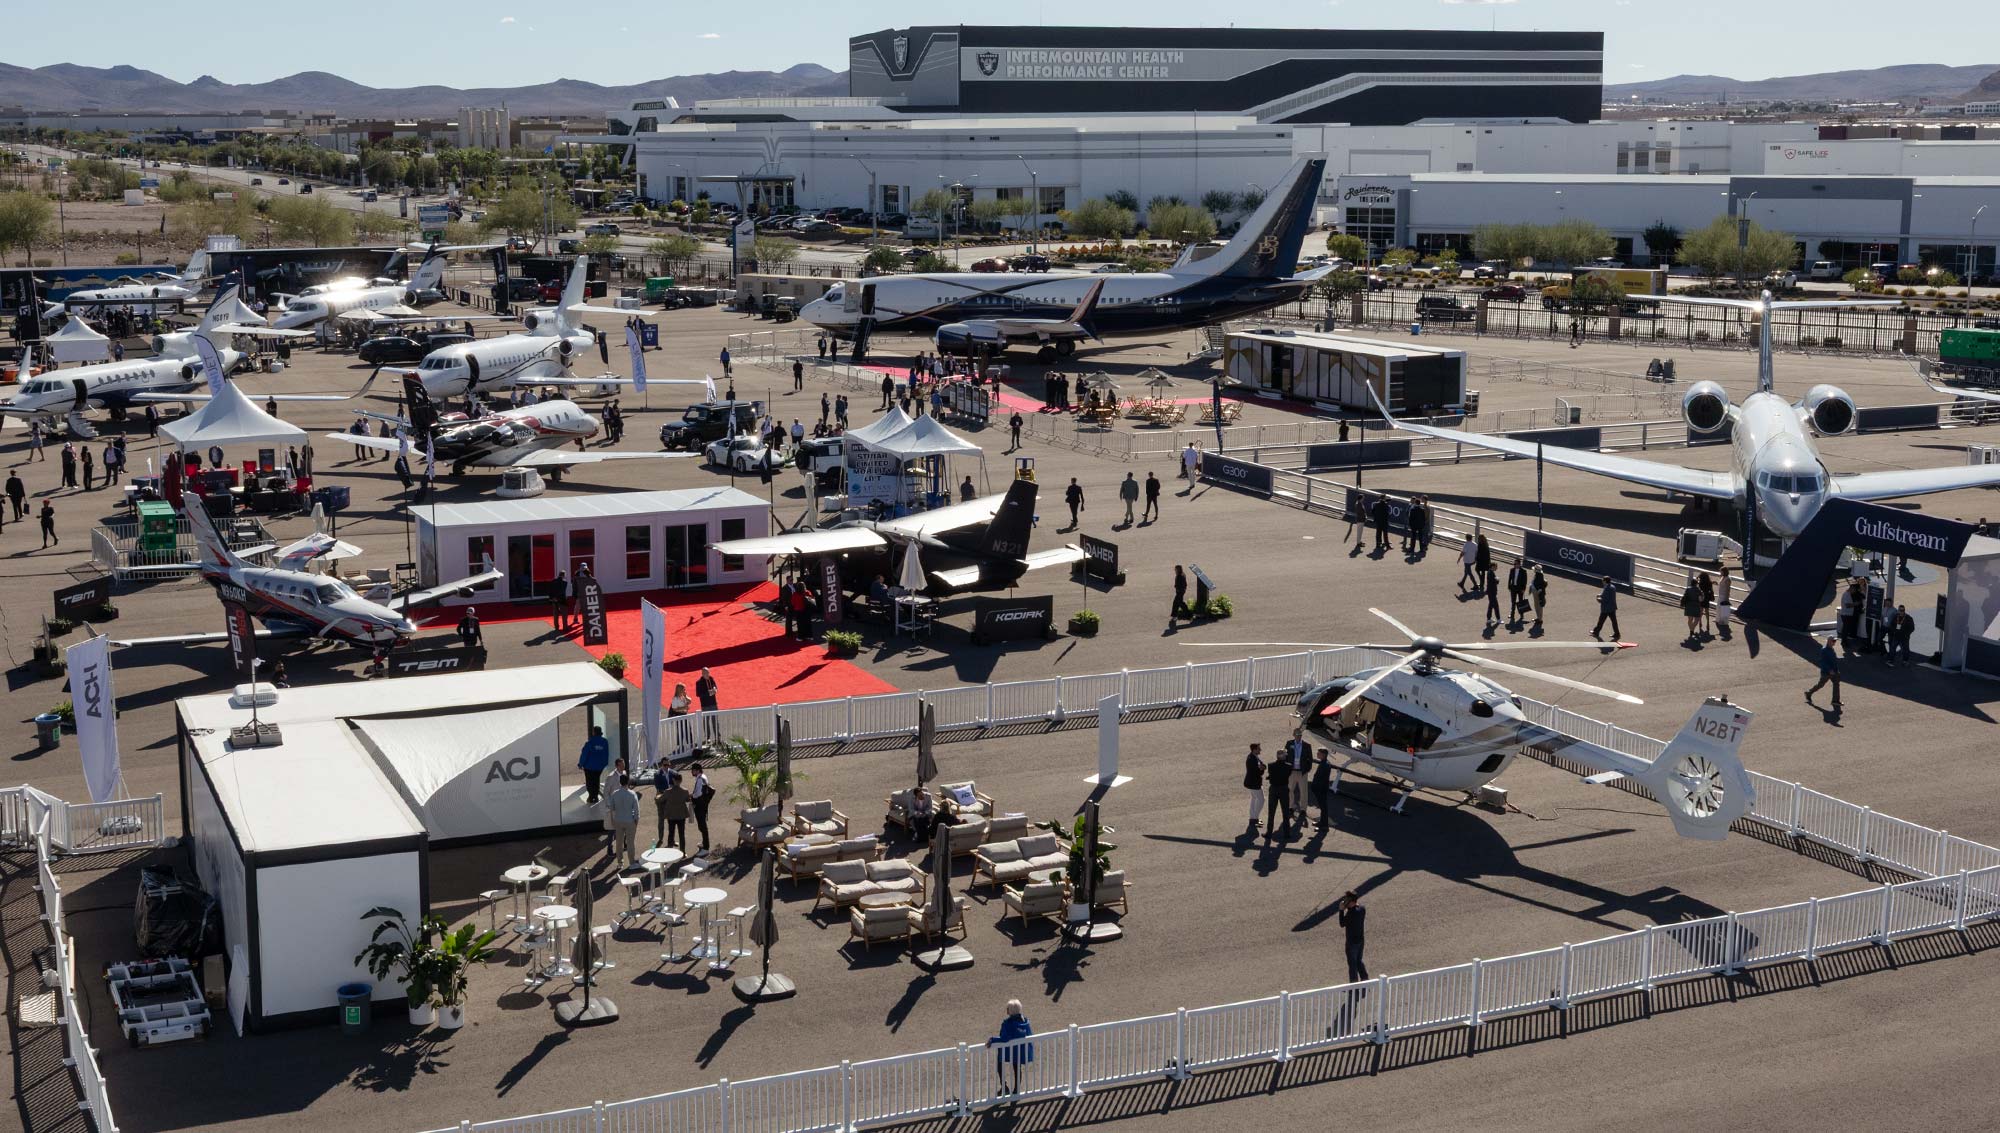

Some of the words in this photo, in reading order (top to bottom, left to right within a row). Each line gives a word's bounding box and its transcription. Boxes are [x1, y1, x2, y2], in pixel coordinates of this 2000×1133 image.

[1006, 50, 1127, 63] INTERMOUNTAIN
[1132, 51, 1184, 63] HEALTH
[1006, 65, 1113, 78] PERFORMANCE
[1118, 65, 1169, 78] CENTER
[1344, 184, 1395, 200] Raiderettes
[203, 354, 221, 396] MNIJET
[1223, 465, 1246, 479] G300
[1855, 516, 1947, 552] Gulfstream
[1085, 541, 1114, 564] DAHER
[1559, 547, 1593, 565] G500
[60, 590, 95, 605] TBM
[828, 562, 841, 614] DAHER
[584, 584, 603, 638] DAHER
[995, 609, 1046, 622] KODIAK
[228, 615, 243, 670] TBM
[399, 657, 459, 672] TBM
[83, 663, 102, 718] ACH
[1695, 716, 1741, 743] N2BT
[484, 755, 541, 784] ACJ
